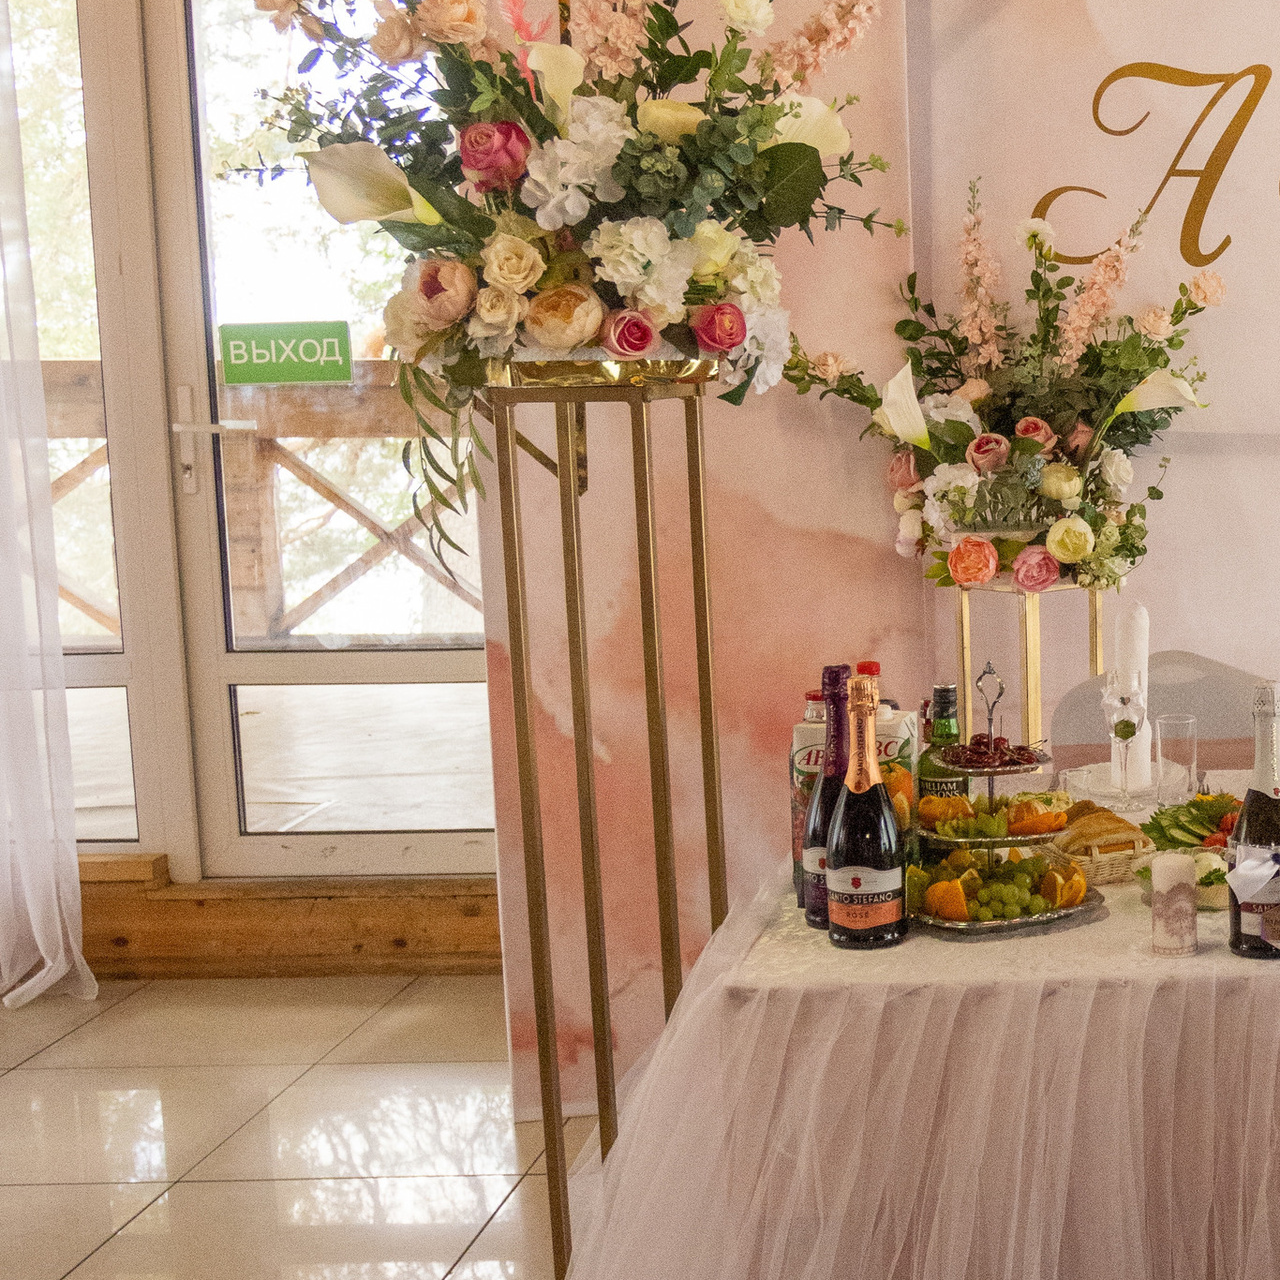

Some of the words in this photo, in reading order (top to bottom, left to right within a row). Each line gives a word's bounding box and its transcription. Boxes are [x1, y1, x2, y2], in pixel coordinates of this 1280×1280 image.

[229, 338, 343, 366] ВЫХОД
[857, 718, 865, 750] STEFANO
[852, 892, 893, 904] STEFANO
